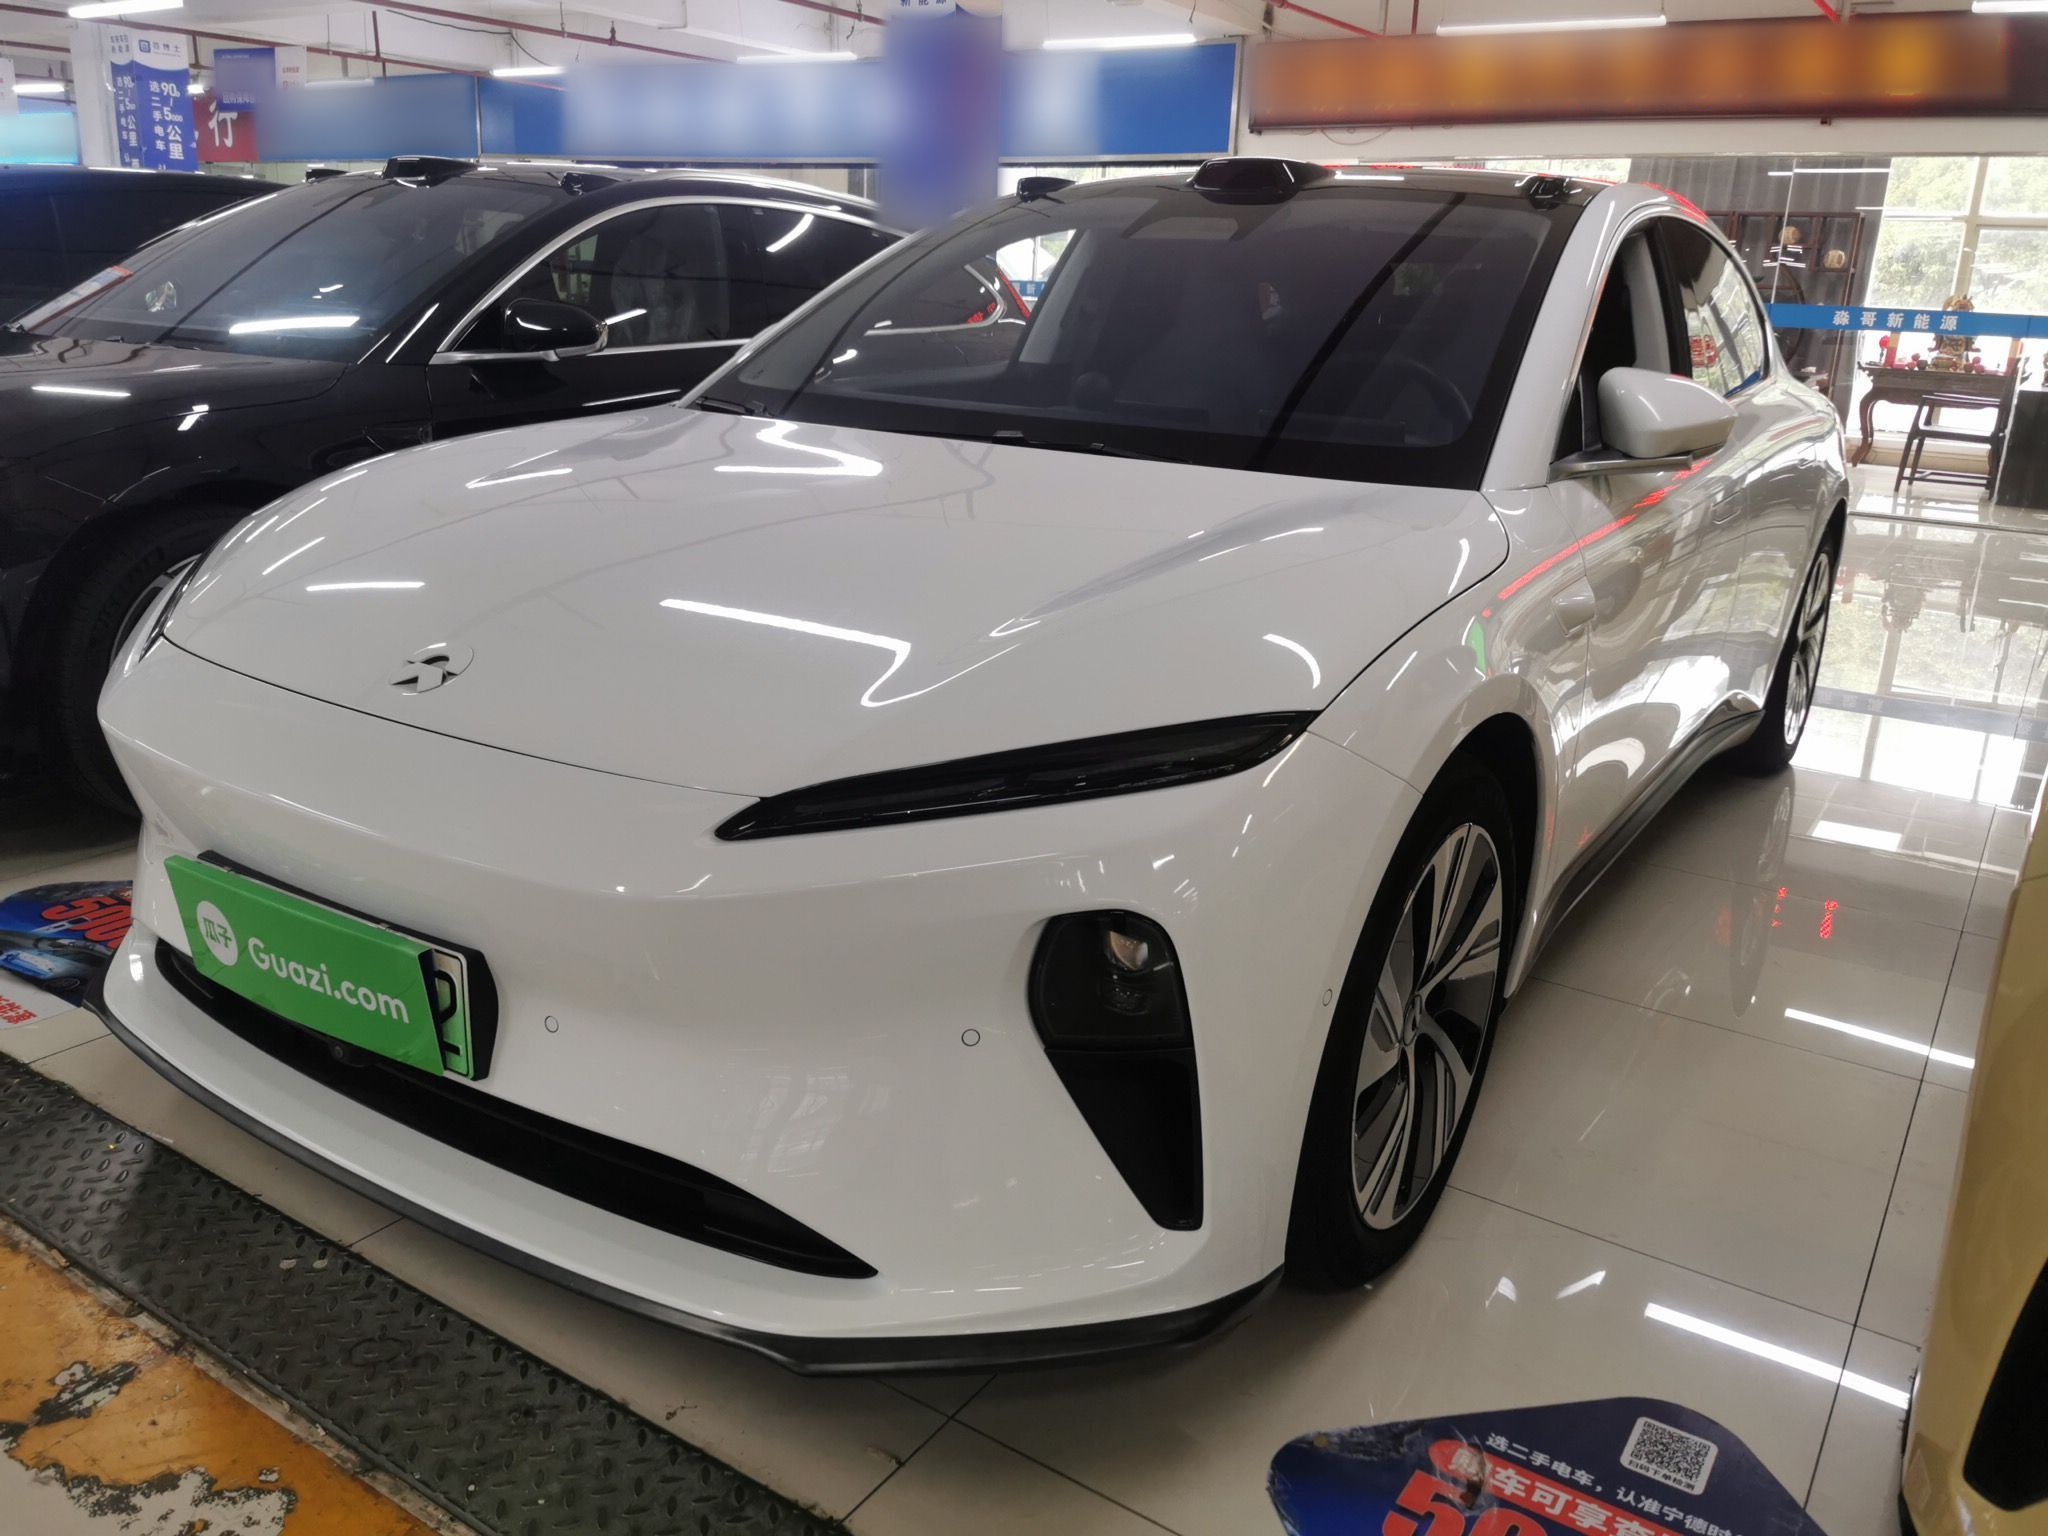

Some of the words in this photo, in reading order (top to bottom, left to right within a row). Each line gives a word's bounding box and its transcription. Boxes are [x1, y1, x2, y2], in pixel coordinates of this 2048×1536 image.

[202, 917, 233, 949] 瓜子
[247, 936, 410, 1025] Guazi.com
[1628, 1459, 1696, 1492] 扫码下单检测
